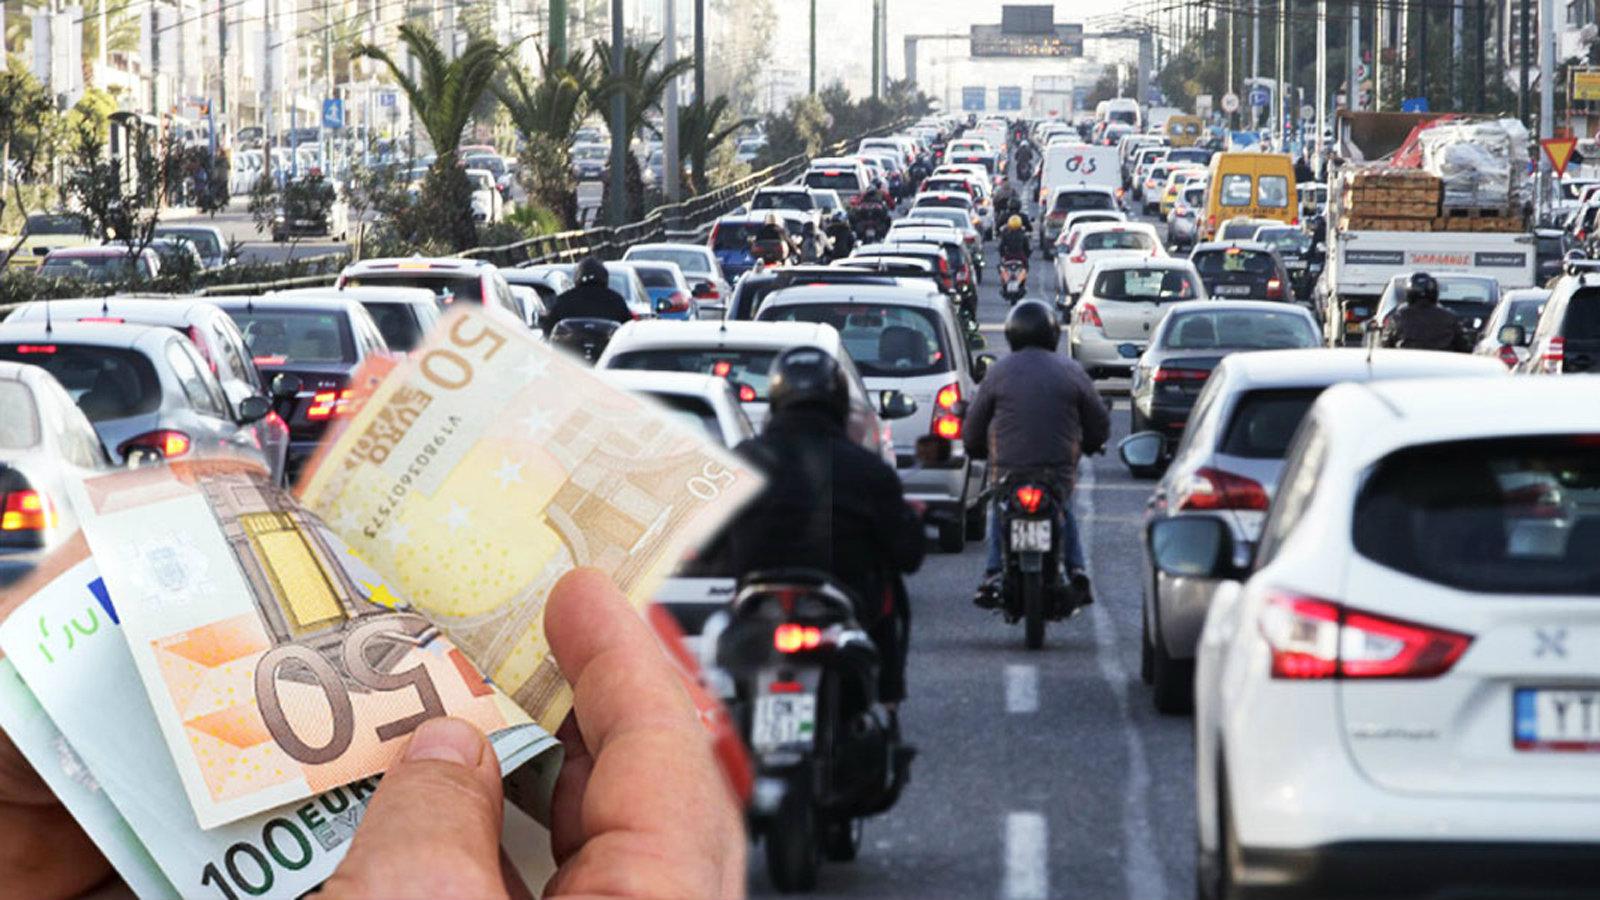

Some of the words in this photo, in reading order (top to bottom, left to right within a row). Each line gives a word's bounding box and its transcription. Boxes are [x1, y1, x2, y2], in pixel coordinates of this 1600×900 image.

[419, 313, 507, 391] 50
[369, 388, 433, 465] EURO
[363, 415, 462, 539] V19803607573
[686, 460, 736, 500] 50
[254, 612, 447, 765] 50
[201, 817, 313, 900] 100
